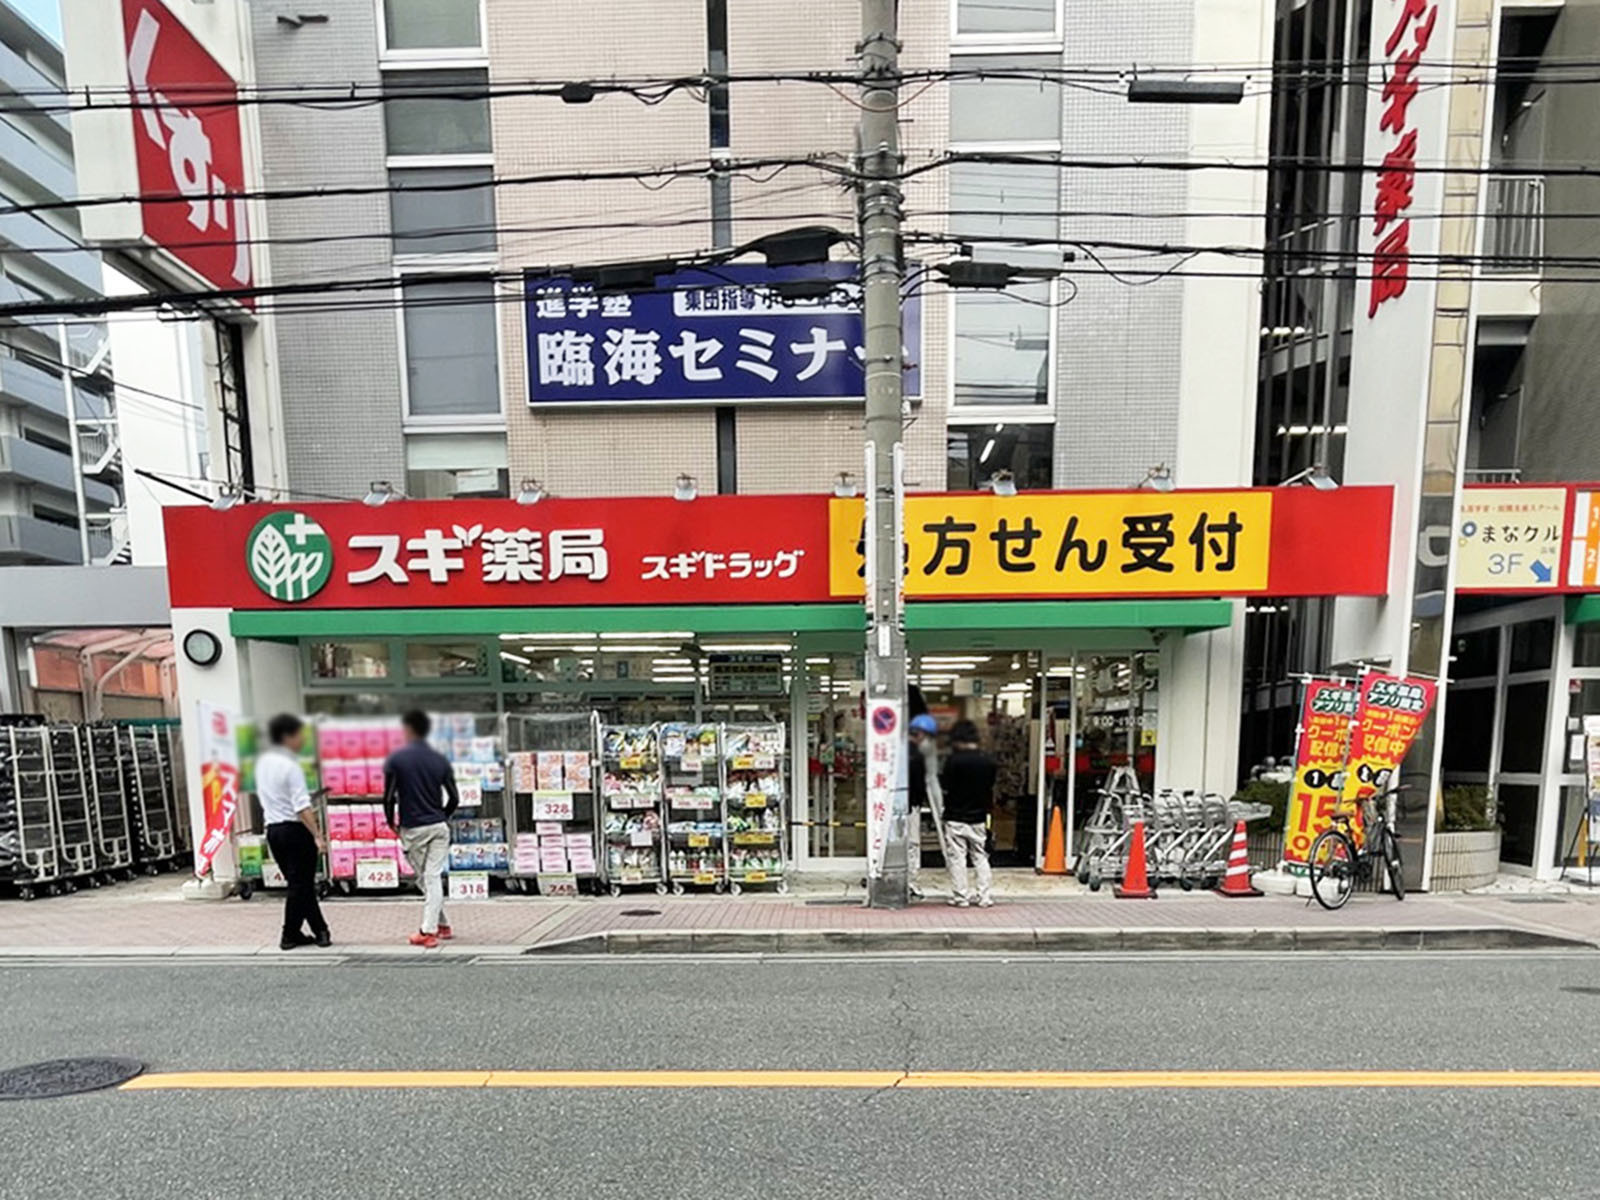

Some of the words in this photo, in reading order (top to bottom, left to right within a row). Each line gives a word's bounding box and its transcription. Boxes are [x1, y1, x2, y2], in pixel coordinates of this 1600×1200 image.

[536, 287, 632, 318] 進学塾
[537, 327, 908, 386] 臨海セミナ
[1482, 525, 1560, 543] まなクル
[346, 523, 609, 586] スギ薬局
[641, 549, 804, 580] スギドラッグ
[1487, 553, 1524, 575] 3F
[544, 803, 569, 815] 328
[367, 871, 393, 882] 428
[459, 884, 484, 895] 318
